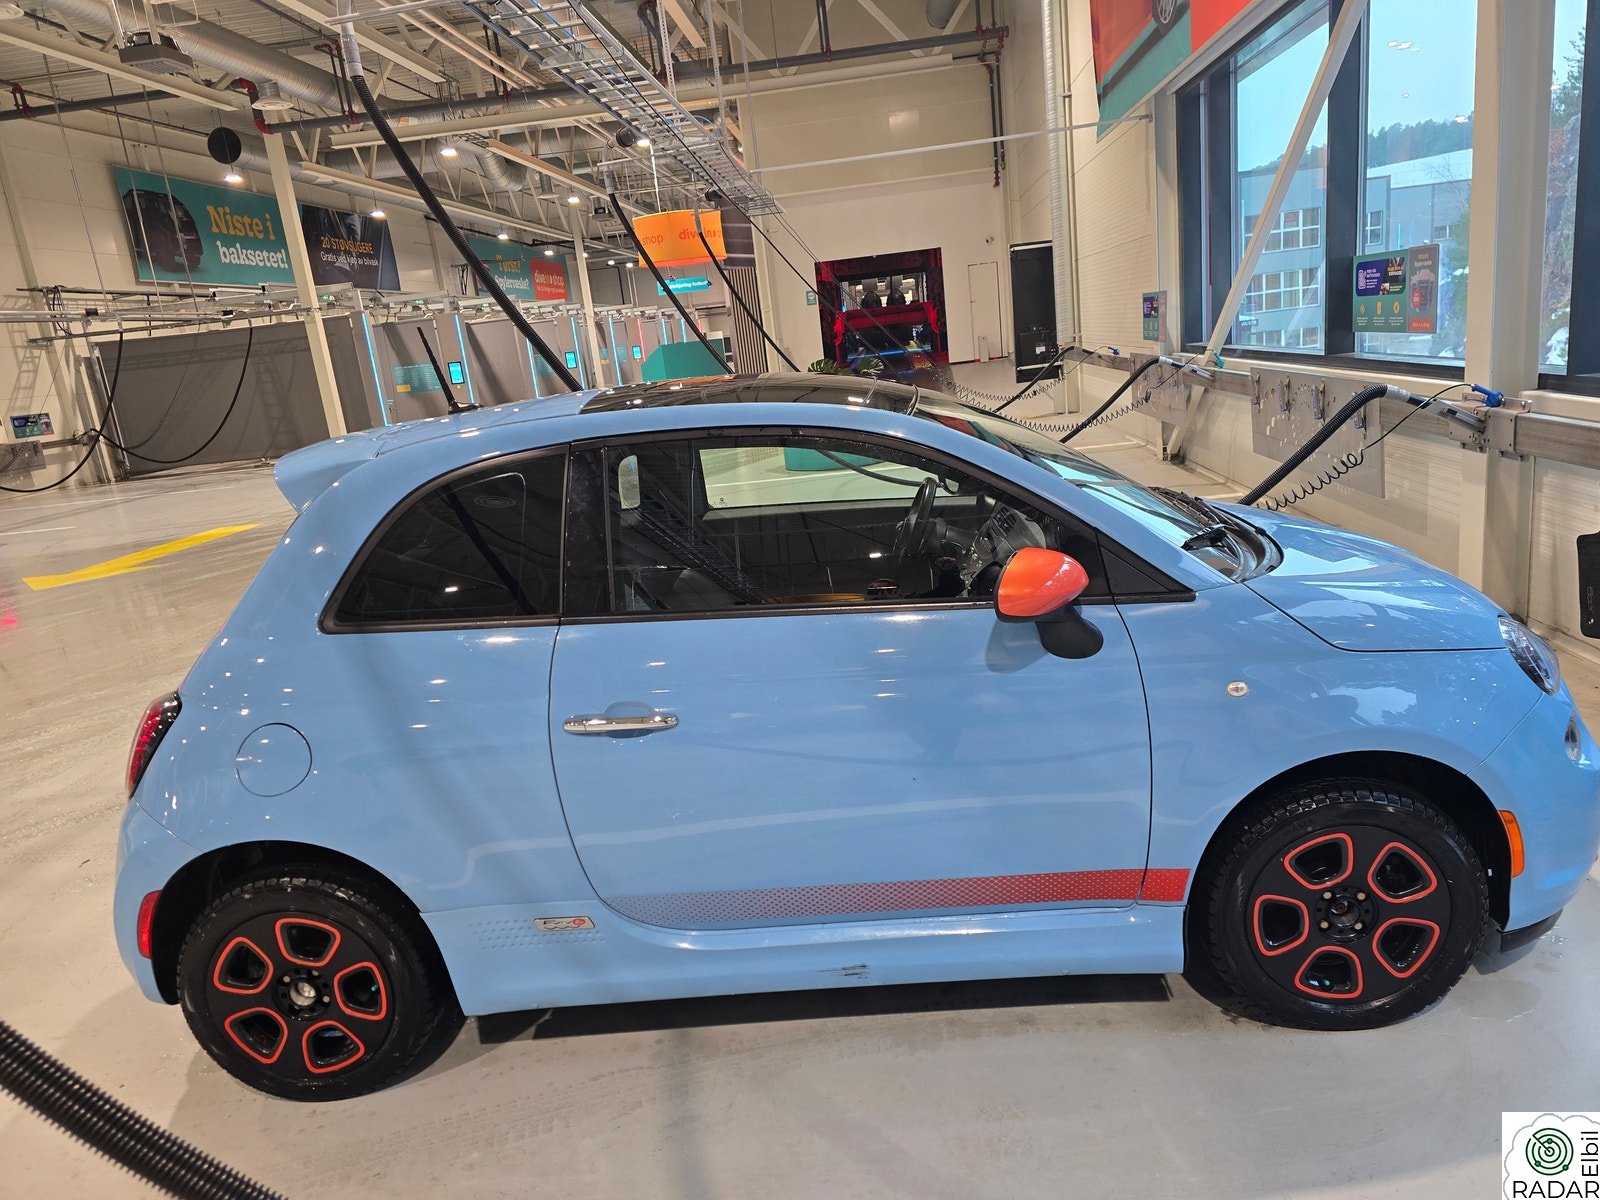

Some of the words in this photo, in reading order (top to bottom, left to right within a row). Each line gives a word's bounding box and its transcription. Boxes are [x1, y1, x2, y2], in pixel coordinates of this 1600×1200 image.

[206, 205, 264, 239] Niste
[265, 213, 275, 240] i
[320, 236, 330, 249] 20
[331, 238, 374, 254] STØVSUGERE
[642, 234, 664, 246] shop
[216, 240, 288, 269] baksetet!
[320, 251, 337, 262] Gratis
